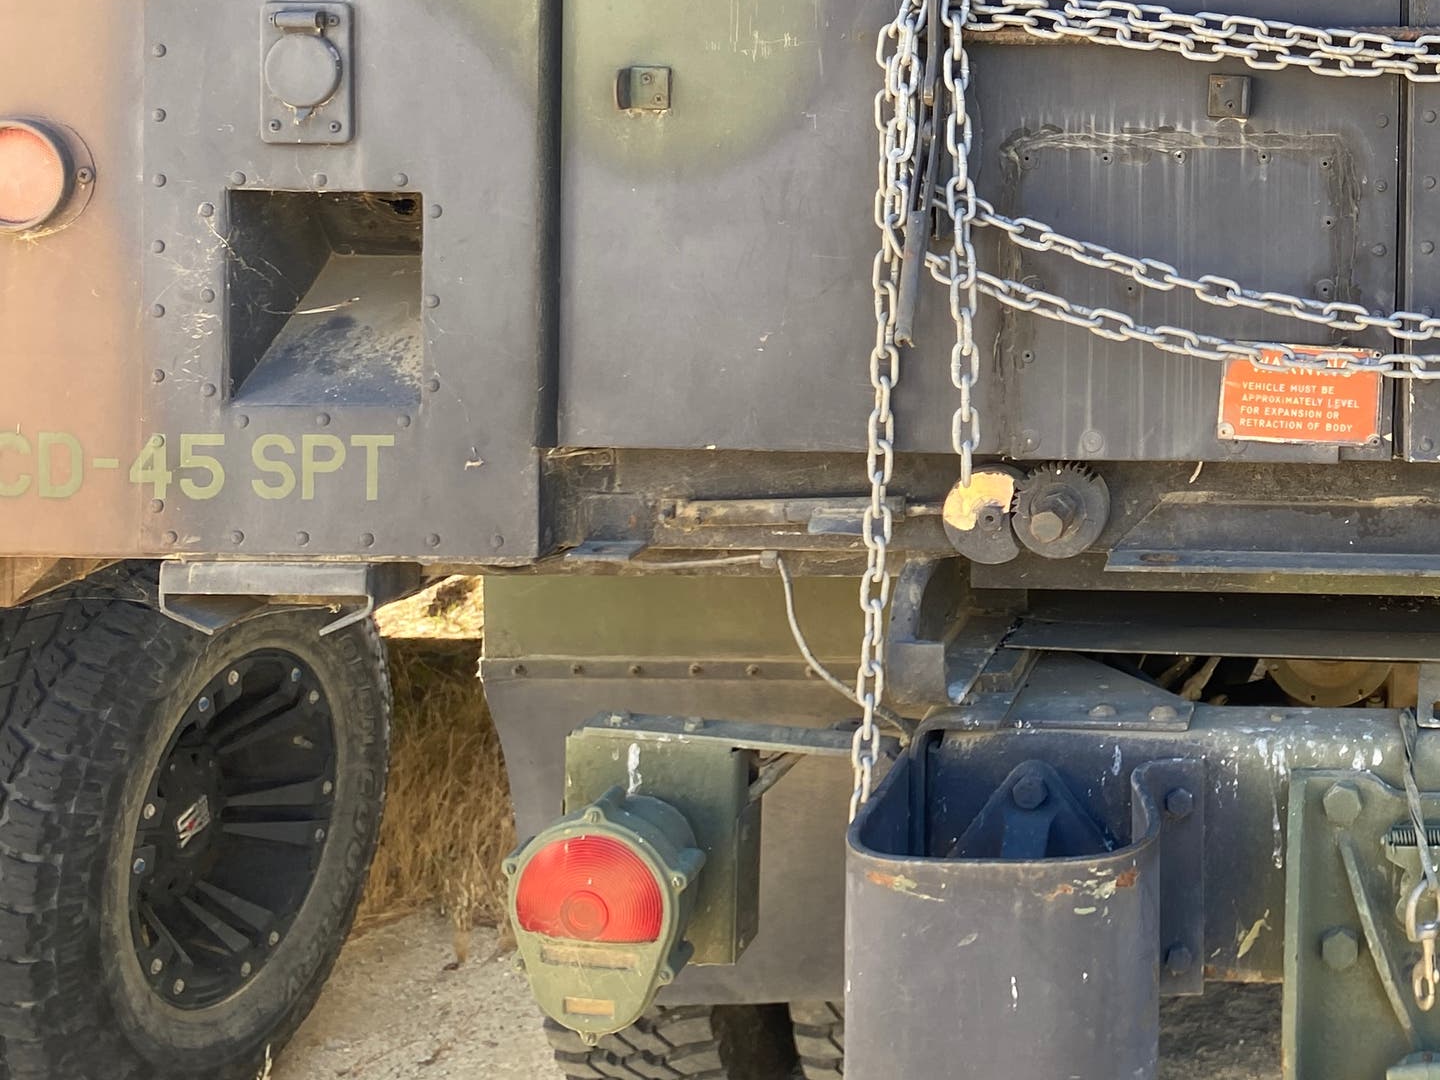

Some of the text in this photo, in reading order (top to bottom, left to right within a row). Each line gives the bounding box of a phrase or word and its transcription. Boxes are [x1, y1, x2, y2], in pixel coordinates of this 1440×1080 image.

[1242, 381, 1335, 395] VEHICLE MUST BE
[1241, 393, 1360, 409] APPROXIMATELY LEVEL
[1240, 405, 1340, 420] FOR EXPANSION OR
[1239, 418, 1353, 433] RETRACTION OF BODY
[0, 430, 396, 501] CD-45 SPT
